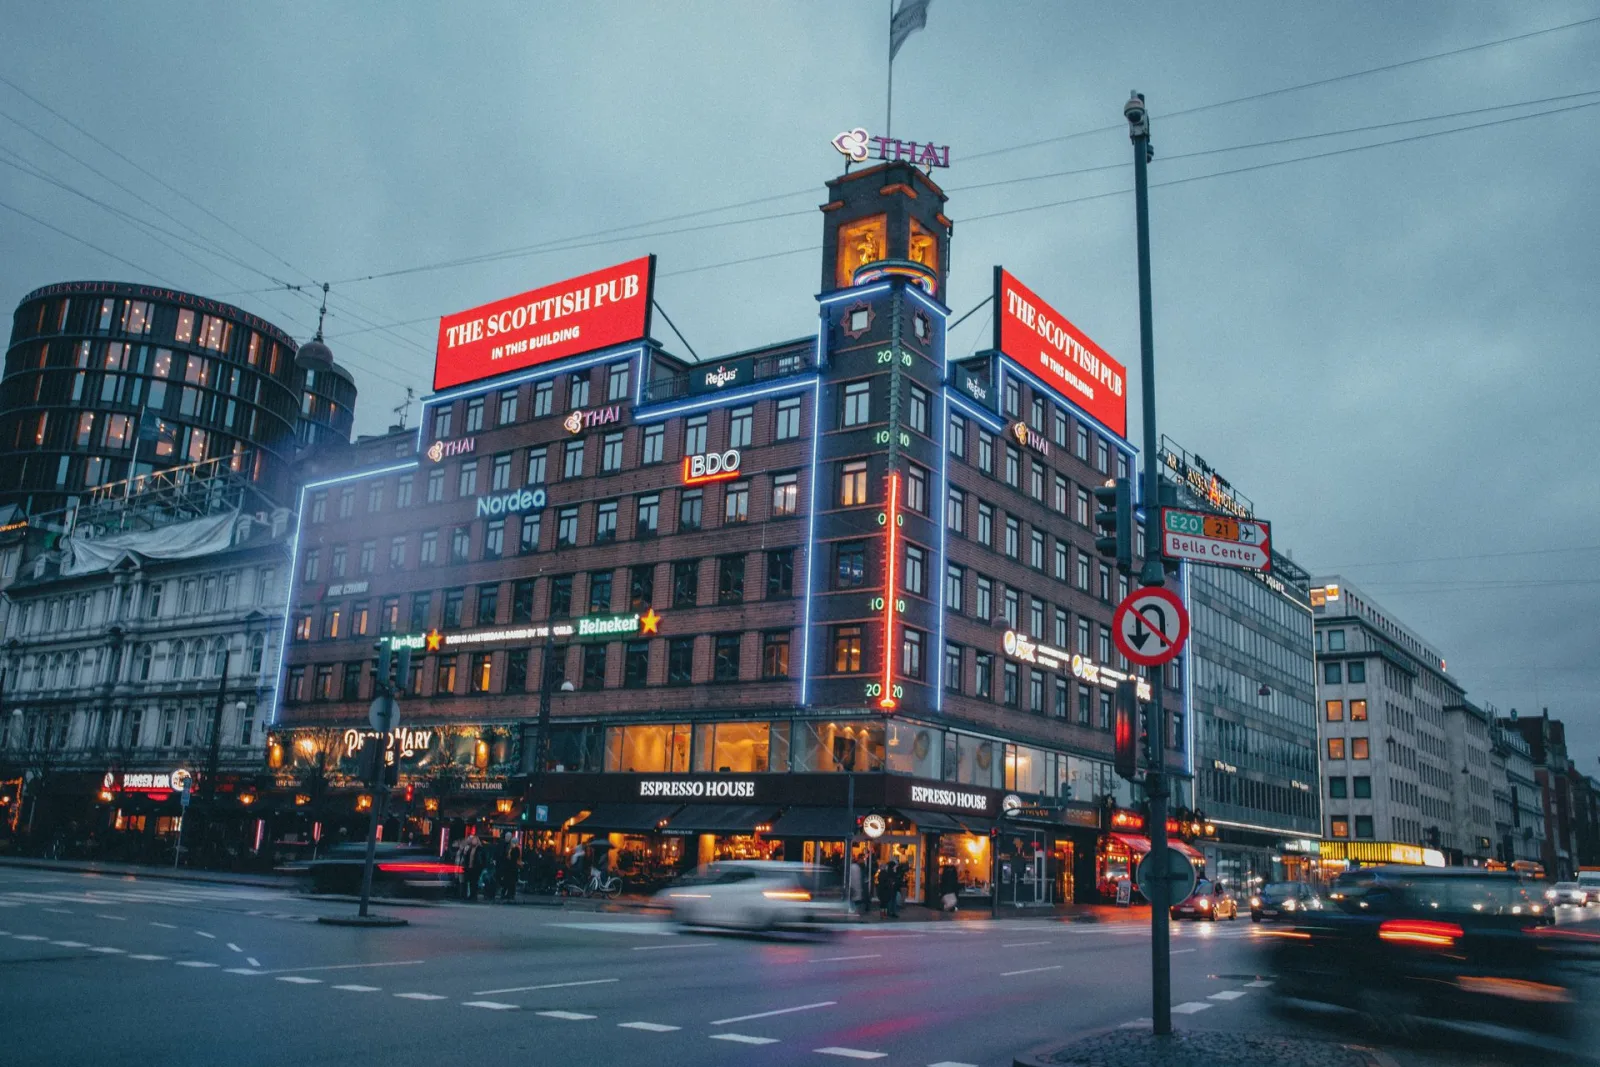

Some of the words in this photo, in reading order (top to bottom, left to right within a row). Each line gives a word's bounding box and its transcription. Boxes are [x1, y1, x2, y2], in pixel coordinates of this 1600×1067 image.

[874, 135, 950, 168] THAI
[446, 319, 484, 348] THE
[486, 287, 591, 337] SCOTTISH
[594, 274, 639, 307] PUB
[491, 347, 503, 360] IN
[505, 339, 527, 356] THIS
[529, 326, 580, 350] BUILDING
[1007, 288, 1036, 331] THE
[1037, 313, 1100, 380] SCOTTISH
[1101, 361, 1122, 397] PUB
[877, 350, 892, 363] 20
[901, 351, 912, 366] 20
[706, 366, 736, 387] Regus
[1040, 351, 1049, 366] IN
[1049, 358, 1065, 379] THIS
[1065, 369, 1094, 400] BUILDING
[966, 377, 987, 399] Regus
[583, 406, 620, 428] THAI
[443, 437, 475, 457] THAI
[876, 430, 890, 444] 10
[900, 433, 910, 447] 10
[1027, 430, 1049, 456] THAI
[691, 449, 741, 478] BDO
[477, 488, 545, 517] Nordea
[878, 513, 887, 525] 0
[897, 514, 903, 526] 0
[1170, 514, 1198, 531] E20
[1216, 523, 1229, 536] 21
[1172, 538, 1206, 554] Bella
[1211, 544, 1257, 562] Center
[579, 616, 638, 635] Heineken
[395, 727, 432, 758] MARY
[640, 781, 704, 796] ESPRESSO
[705, 781, 755, 797] HOUSE
[911, 785, 956, 807] ESPRESSO
[957, 793, 987, 810] HOUSE
